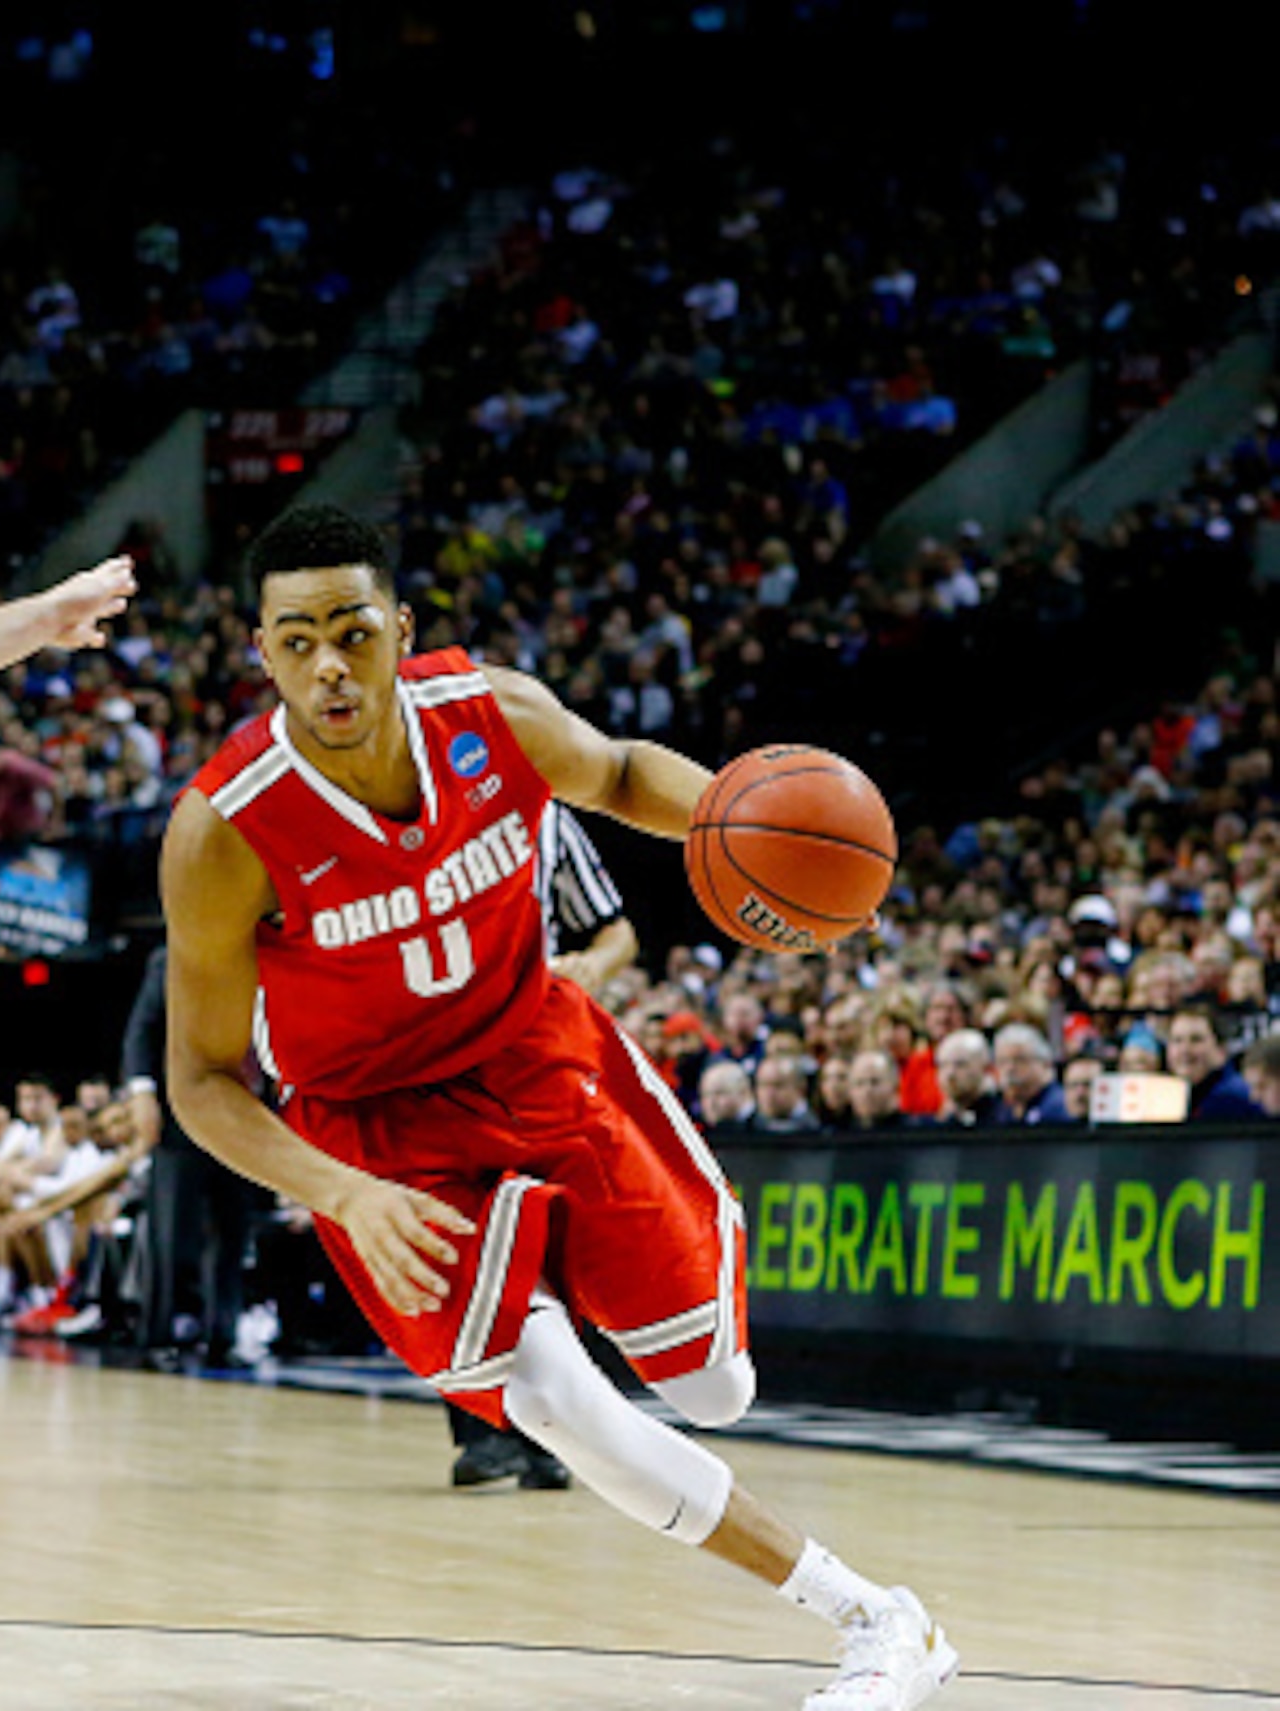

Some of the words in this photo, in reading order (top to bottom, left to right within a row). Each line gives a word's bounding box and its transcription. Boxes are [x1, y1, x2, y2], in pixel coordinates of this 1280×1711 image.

[312, 886, 421, 949] OHIO
[424, 810, 533, 916] STATE
[744, 1183, 984, 1298] EBRATE
[999, 1180, 1266, 1311] MARCH
